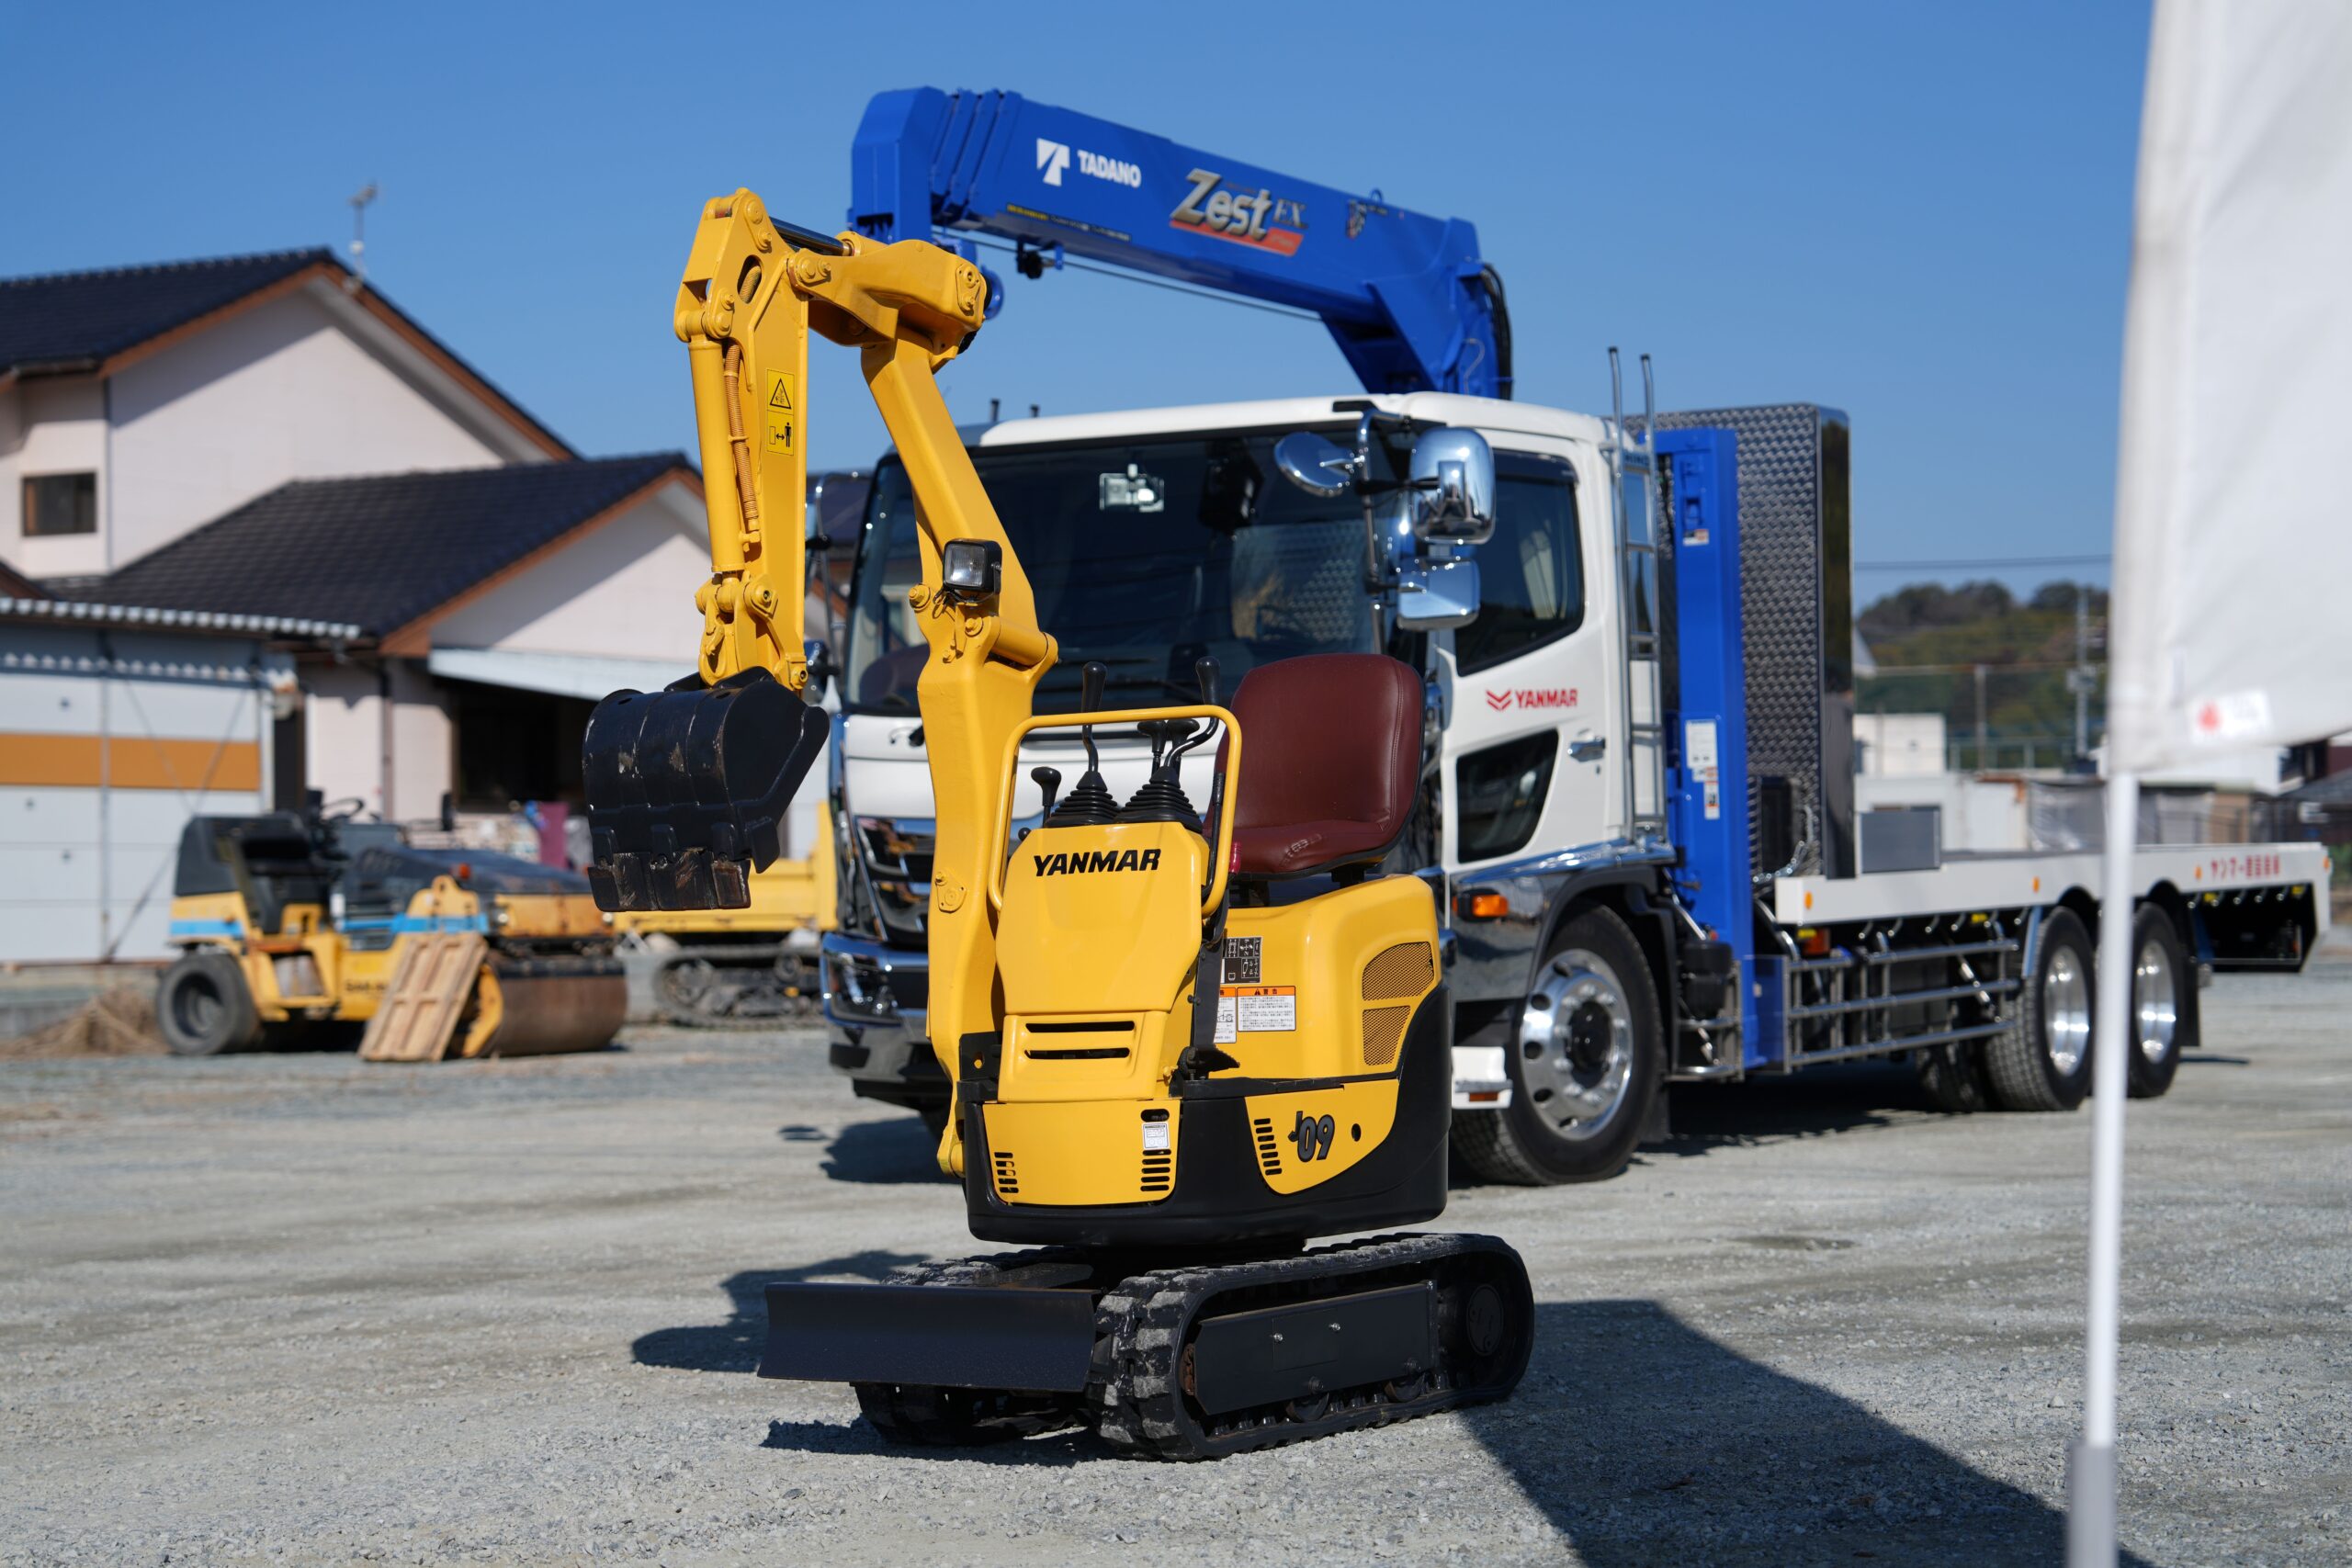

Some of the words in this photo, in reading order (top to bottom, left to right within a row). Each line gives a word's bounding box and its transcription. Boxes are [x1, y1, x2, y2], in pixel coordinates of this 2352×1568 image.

[1077, 149, 1142, 188] TADANO
[1170, 167, 1272, 242] Zest
[1515, 689, 1577, 708] YANMAR
[1034, 849, 1161, 877] YANMAR
